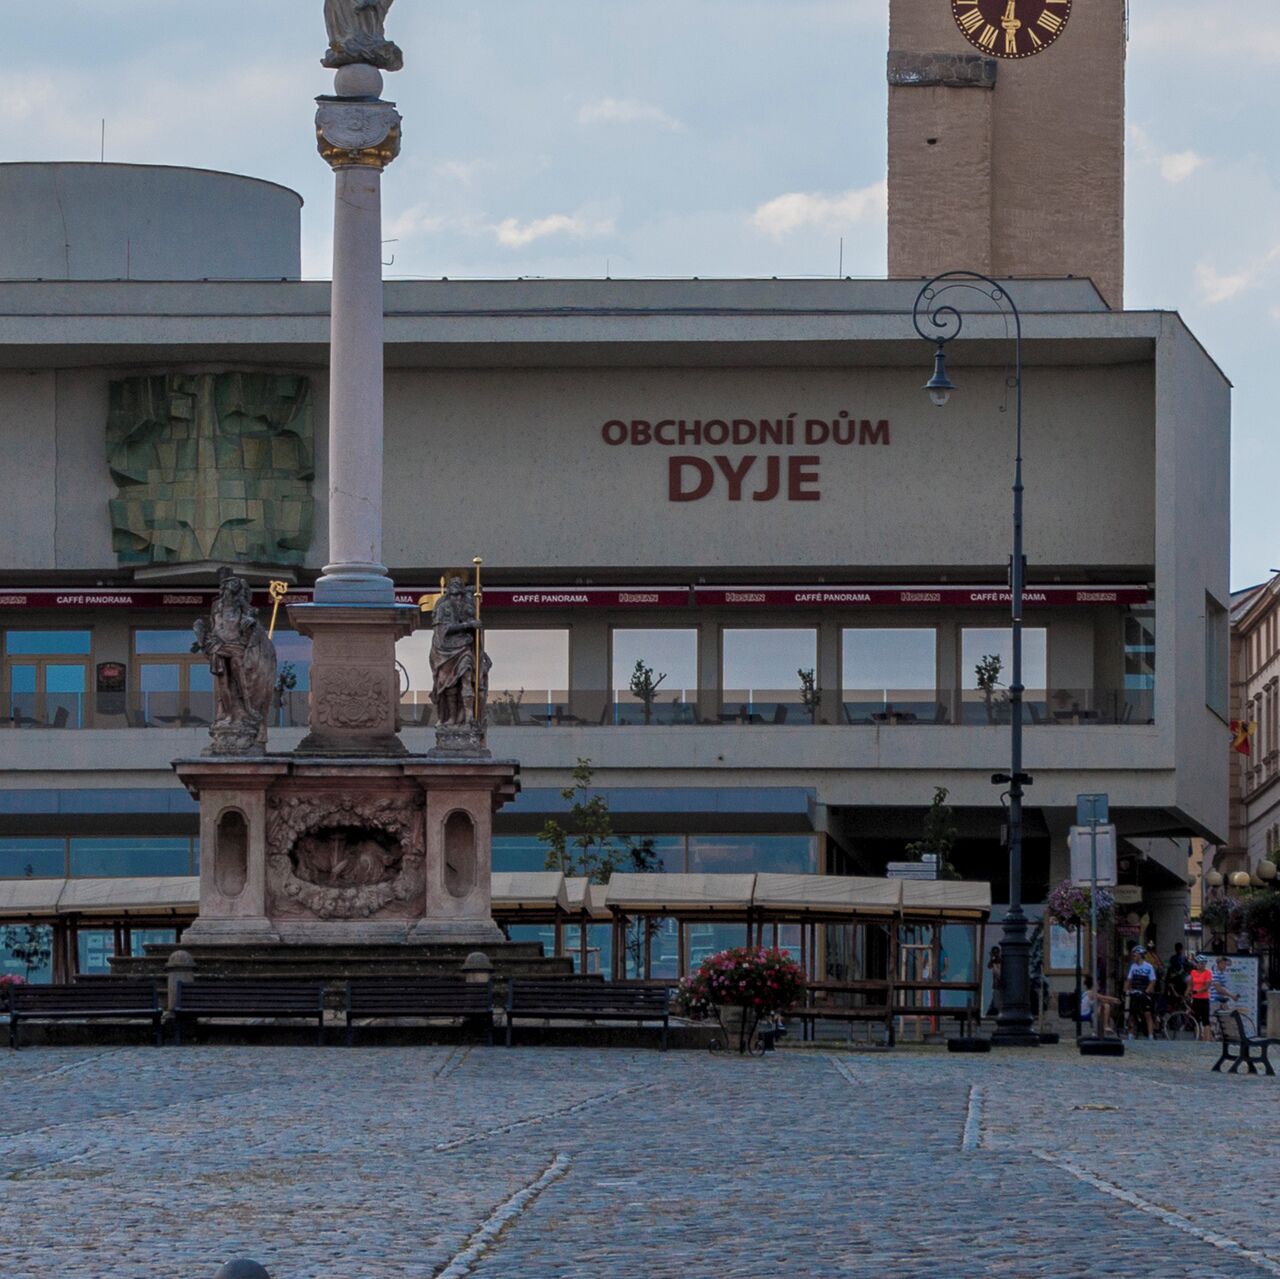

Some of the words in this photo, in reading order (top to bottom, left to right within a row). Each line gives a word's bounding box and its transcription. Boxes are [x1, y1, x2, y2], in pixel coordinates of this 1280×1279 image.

[601, 412, 798, 446] OBCHODNÍ
[805, 410, 890, 446] DŮM
[668, 455, 821, 502] DYJE
[56, 595, 84, 604] CAFFÉ
[85, 595, 133, 604] PANORAMA
[512, 594, 539, 603] CAFFÉ
[541, 595, 588, 603] PANORAMA
[795, 593, 822, 602] CAFFÉ
[824, 593, 871, 602] PANORAMA
[970, 592, 997, 601] CAFFÉ
